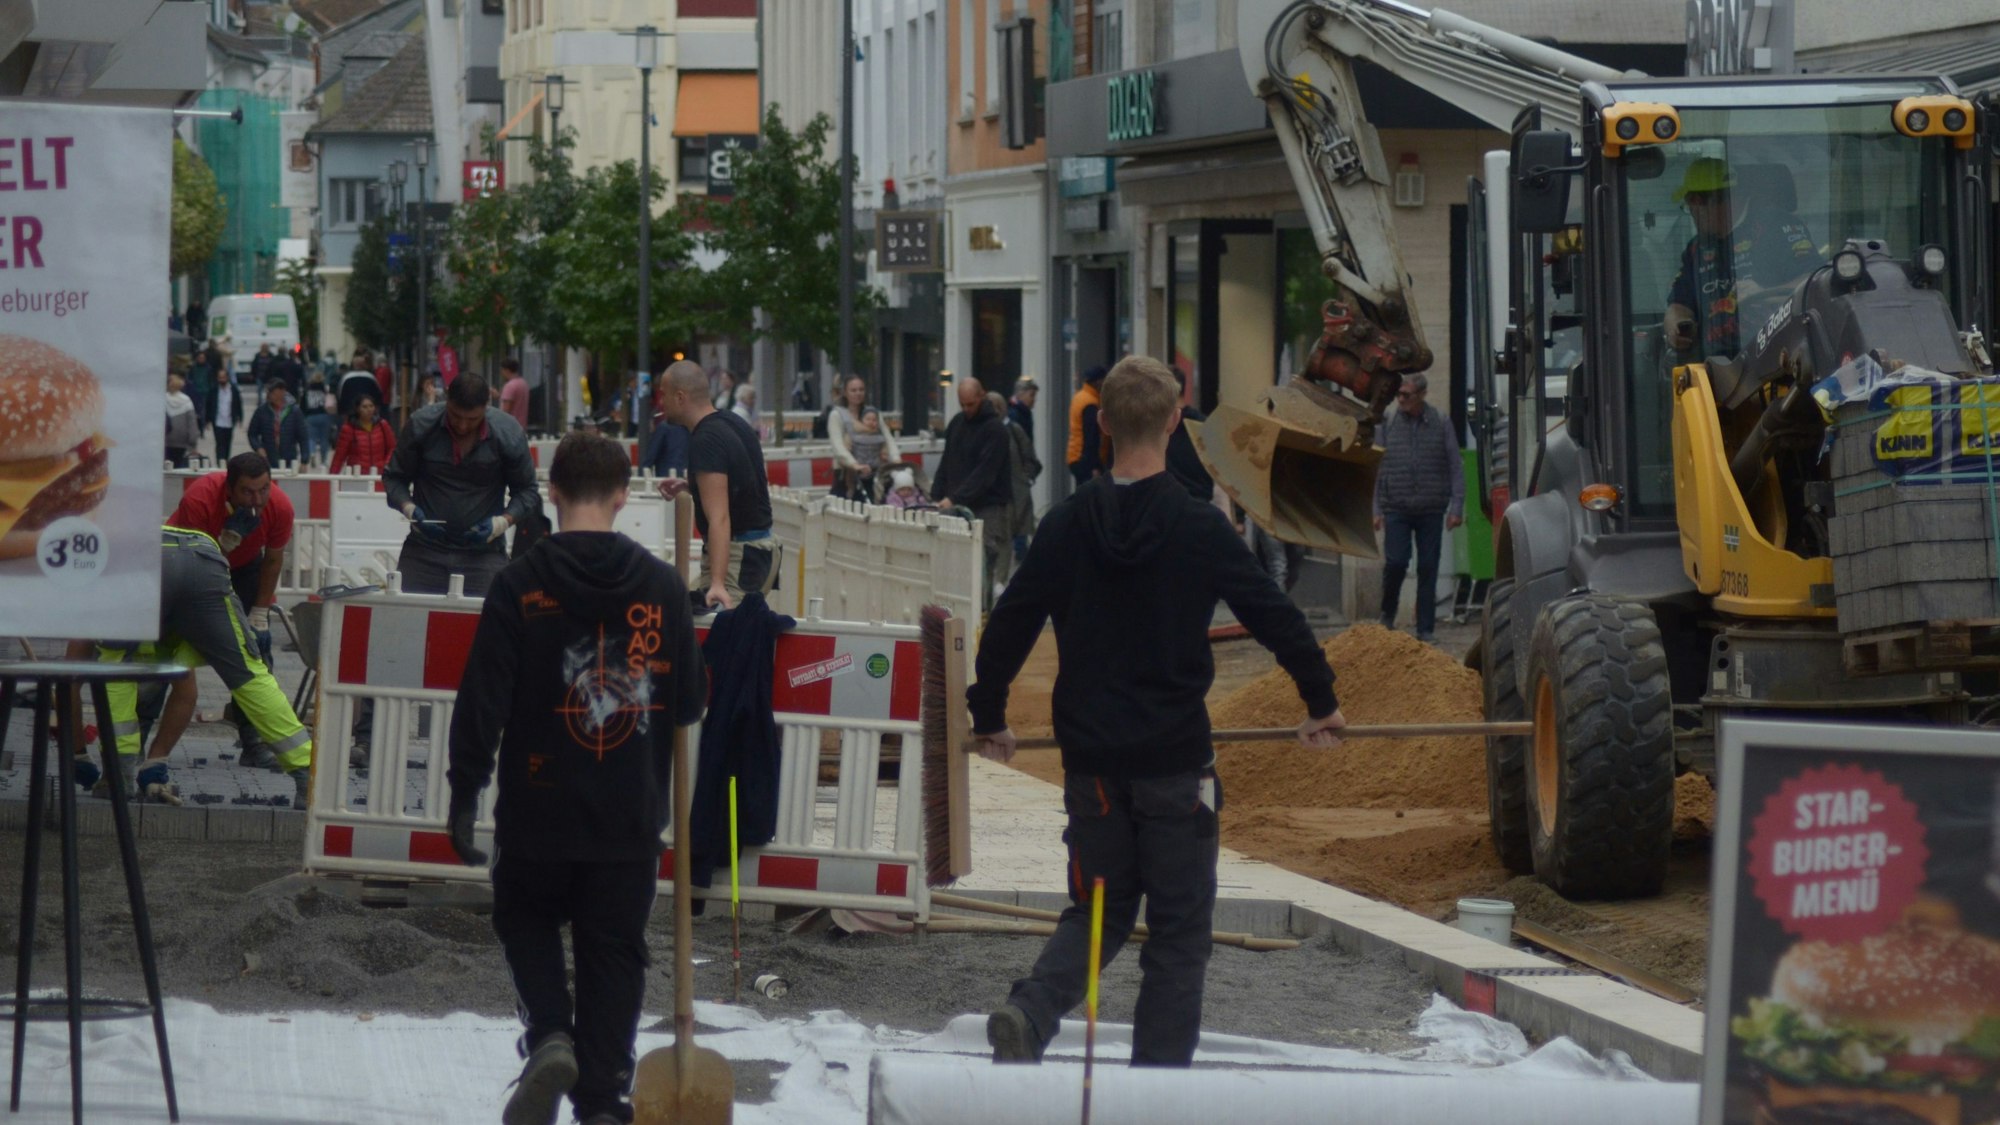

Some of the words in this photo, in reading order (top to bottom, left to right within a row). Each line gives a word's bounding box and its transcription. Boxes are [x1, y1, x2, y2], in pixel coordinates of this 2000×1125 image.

[46, 538, 67, 568] 3
[72, 533, 98, 555] 80
[73, 559, 96, 569] Euro
[1720, 569, 1749, 597] 87368
[1794, 789, 1885, 830] STAR-
[1772, 831, 1903, 876] BURGER-
[1791, 868, 1879, 918] MENÜ
